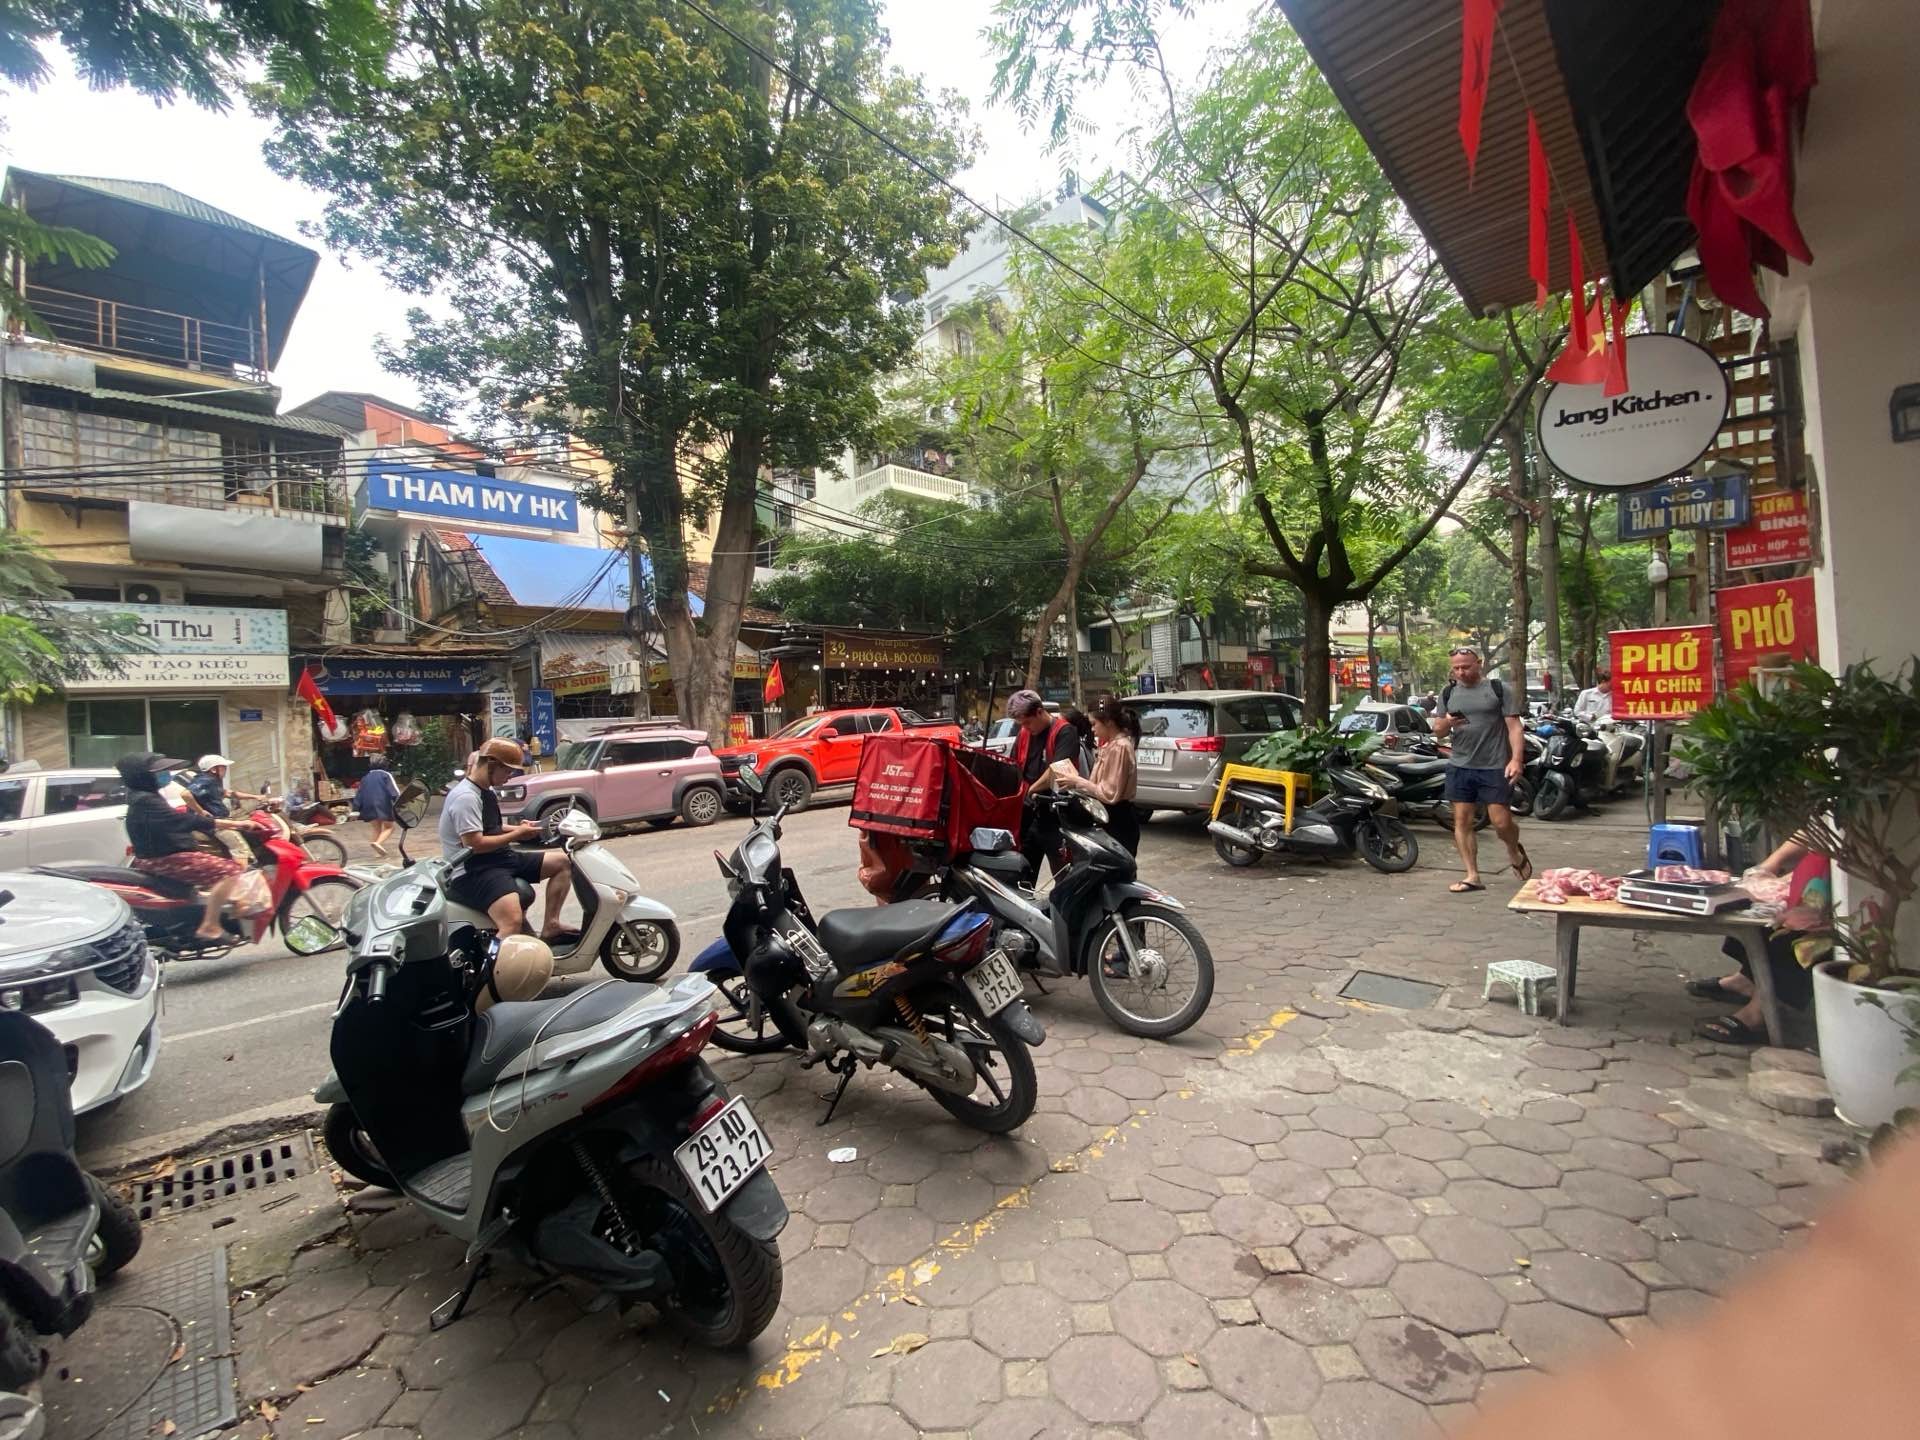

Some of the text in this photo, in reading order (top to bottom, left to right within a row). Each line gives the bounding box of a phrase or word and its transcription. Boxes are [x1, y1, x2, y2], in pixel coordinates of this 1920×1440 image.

[1554, 409, 1609, 428] Jang
[380, 473, 568, 521] THAM MY HK
[1731, 588, 1796, 650] PHỞ
[829, 640, 846, 656] 32
[1621, 631, 1700, 673] PHỞ
[1621, 675, 1702, 694] TÁI CHÍN
[1625, 698, 1655, 716] TÁI
[881, 764, 904, 778] J&T
[984, 974, 1018, 1010] 9754
[701, 1128, 764, 1202] 123.27
